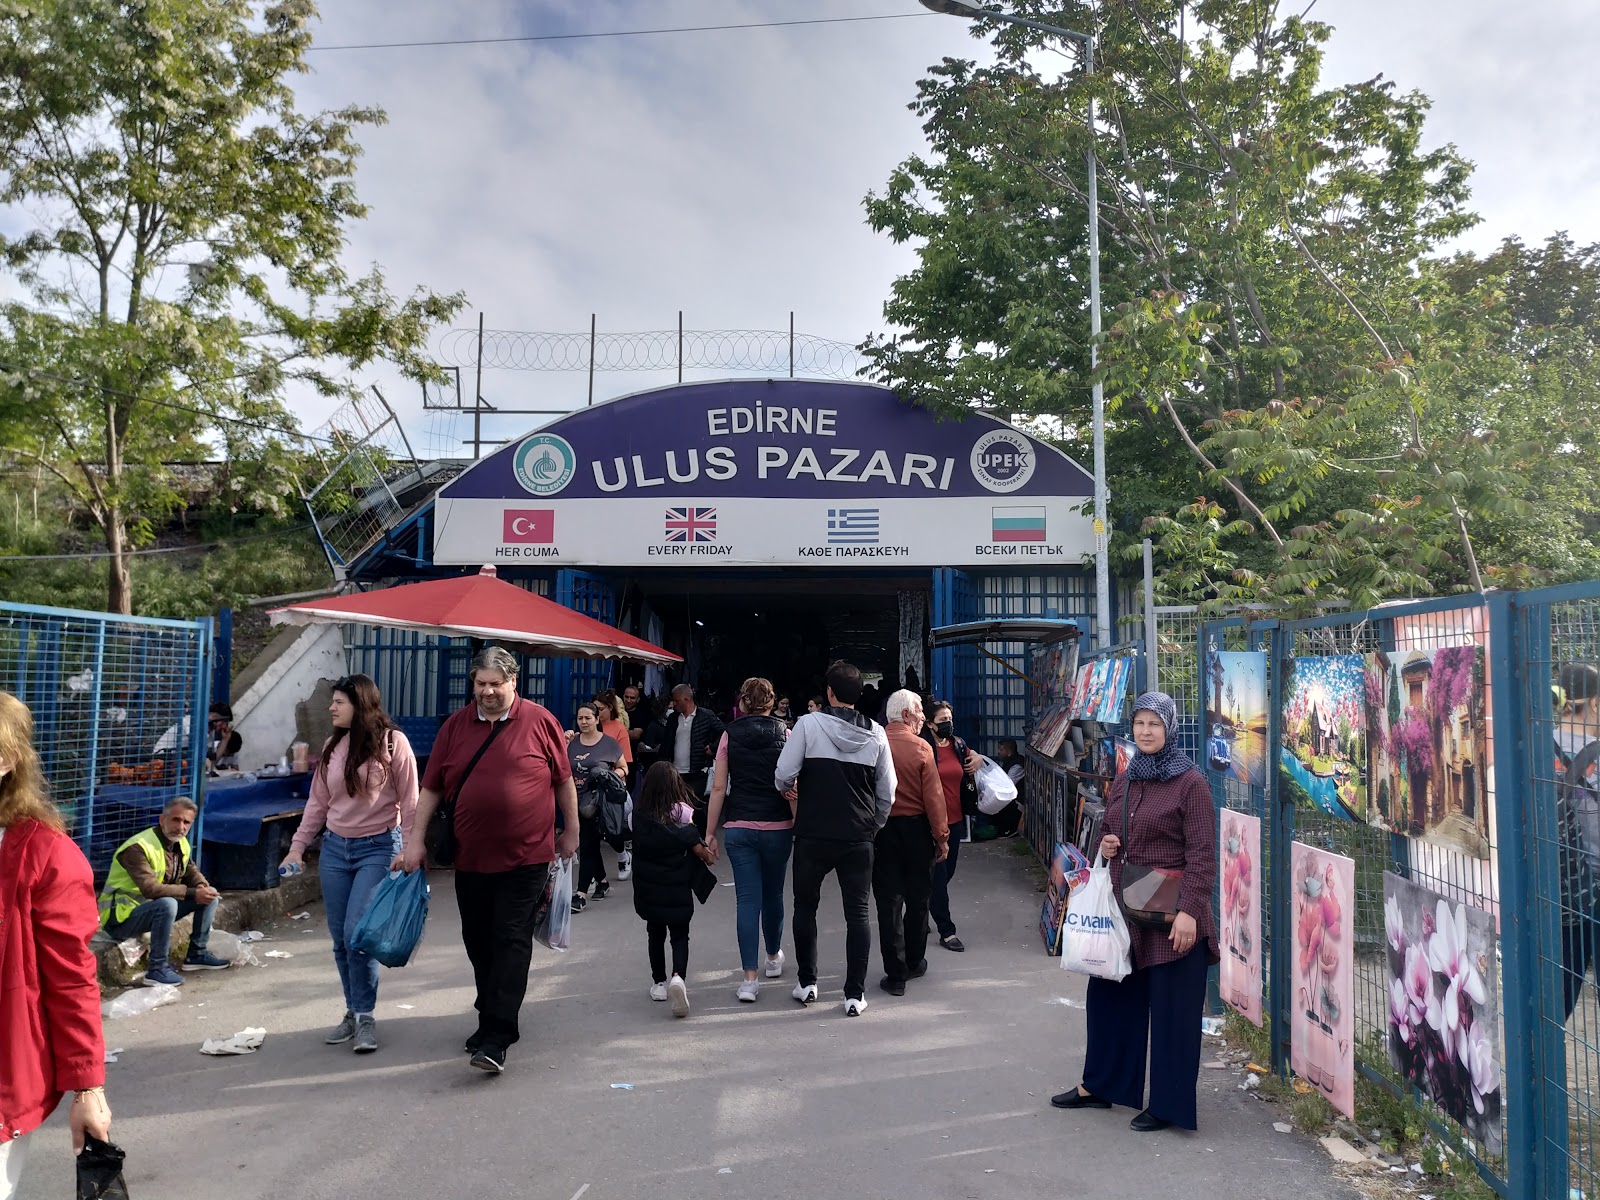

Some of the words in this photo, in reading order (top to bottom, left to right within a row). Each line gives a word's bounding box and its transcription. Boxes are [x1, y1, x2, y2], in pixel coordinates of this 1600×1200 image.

[707, 400, 838, 436] EDİRNE
[979, 436, 996, 451] ULUS
[999, 435, 1025, 451] PAZARI
[976, 452, 1029, 468] UPEK
[591, 446, 738, 492] ULUS
[758, 446, 955, 491] PAZARI
[977, 468, 992, 483] ESNAF
[536, 468, 571, 492] BELEDİYESİ
[495, 547, 520, 557] HER
[523, 546, 560, 557] CUMA
[648, 545, 687, 556] EVERY
[689, 545, 733, 555] FRIDAY
[798, 547, 832, 557] ΚΑΘΕ
[835, 546, 909, 557] ΠΑΡΑΣΚΕΥΗ
[975, 545, 1017, 555] ВСЕКИ
[1020, 545, 1064, 555] ПЕТЪК
[1064, 912, 1079, 925] C
